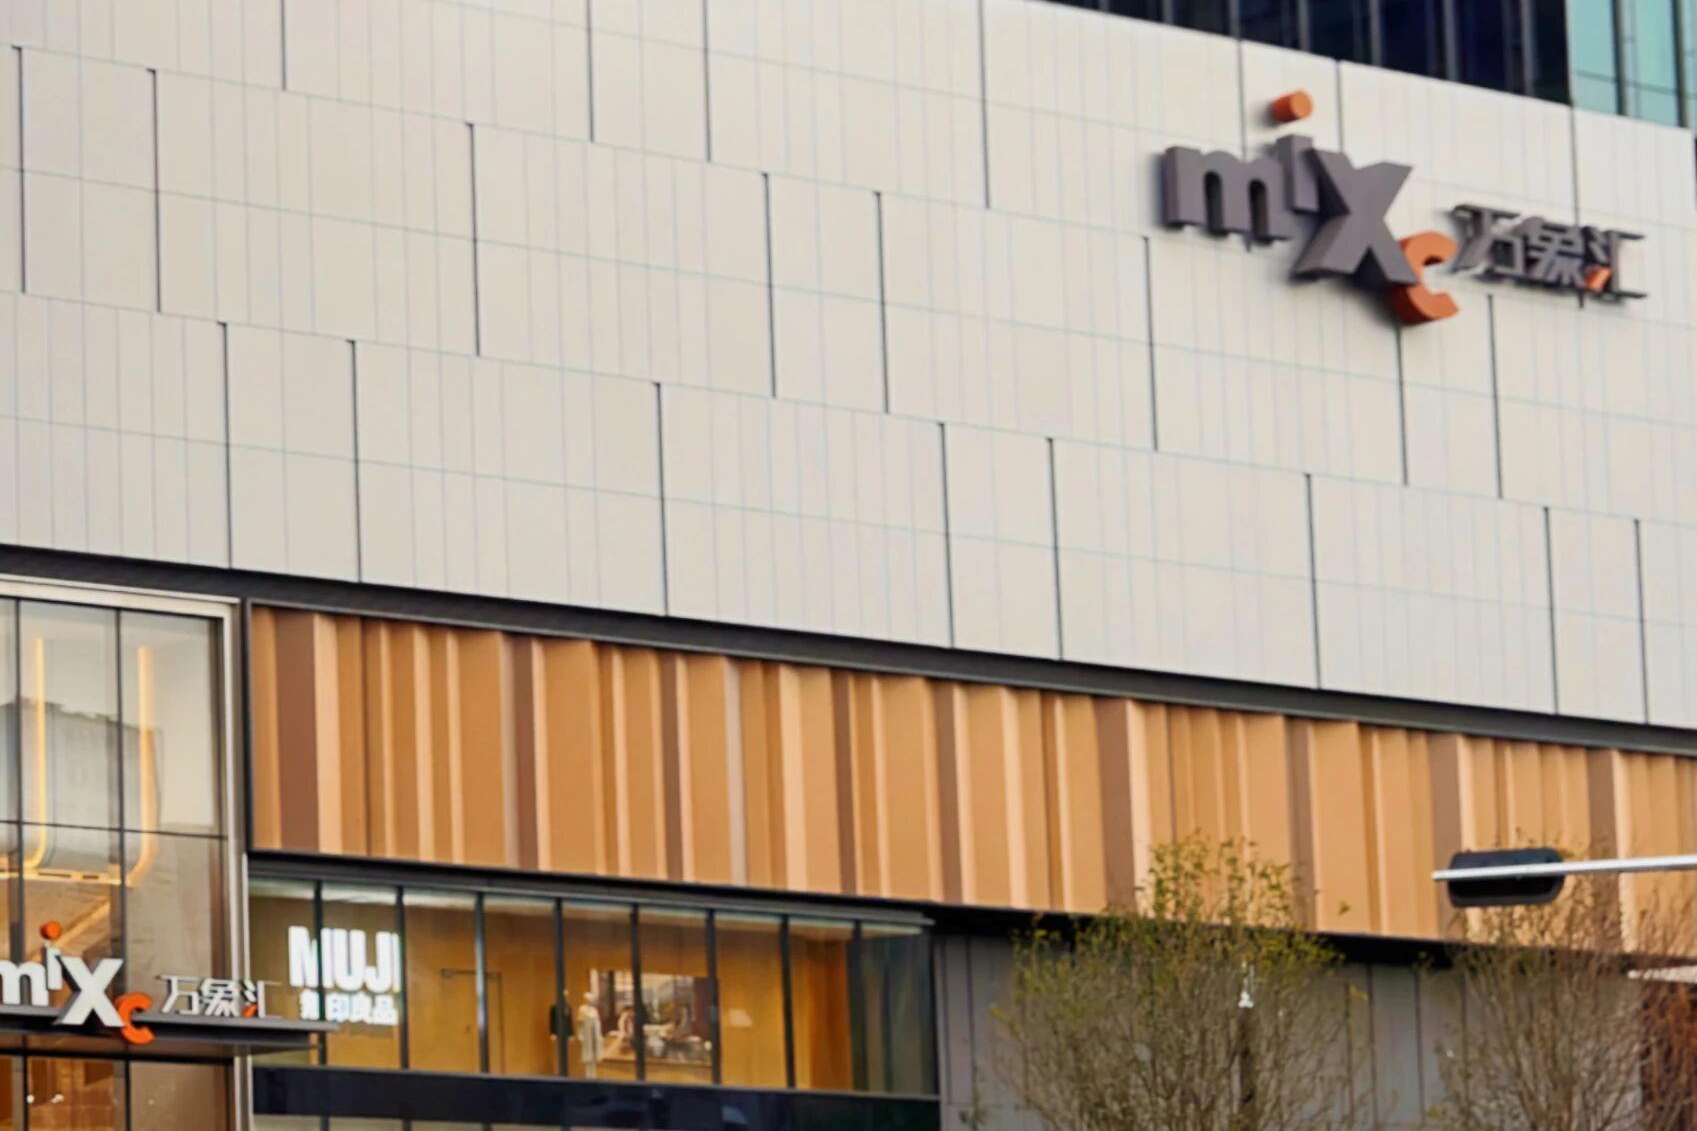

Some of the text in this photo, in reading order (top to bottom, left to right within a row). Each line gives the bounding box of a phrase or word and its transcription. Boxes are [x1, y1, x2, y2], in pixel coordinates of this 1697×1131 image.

[288, 926, 401, 993] MUJI
[156, 974, 281, 1019] 万象汇
